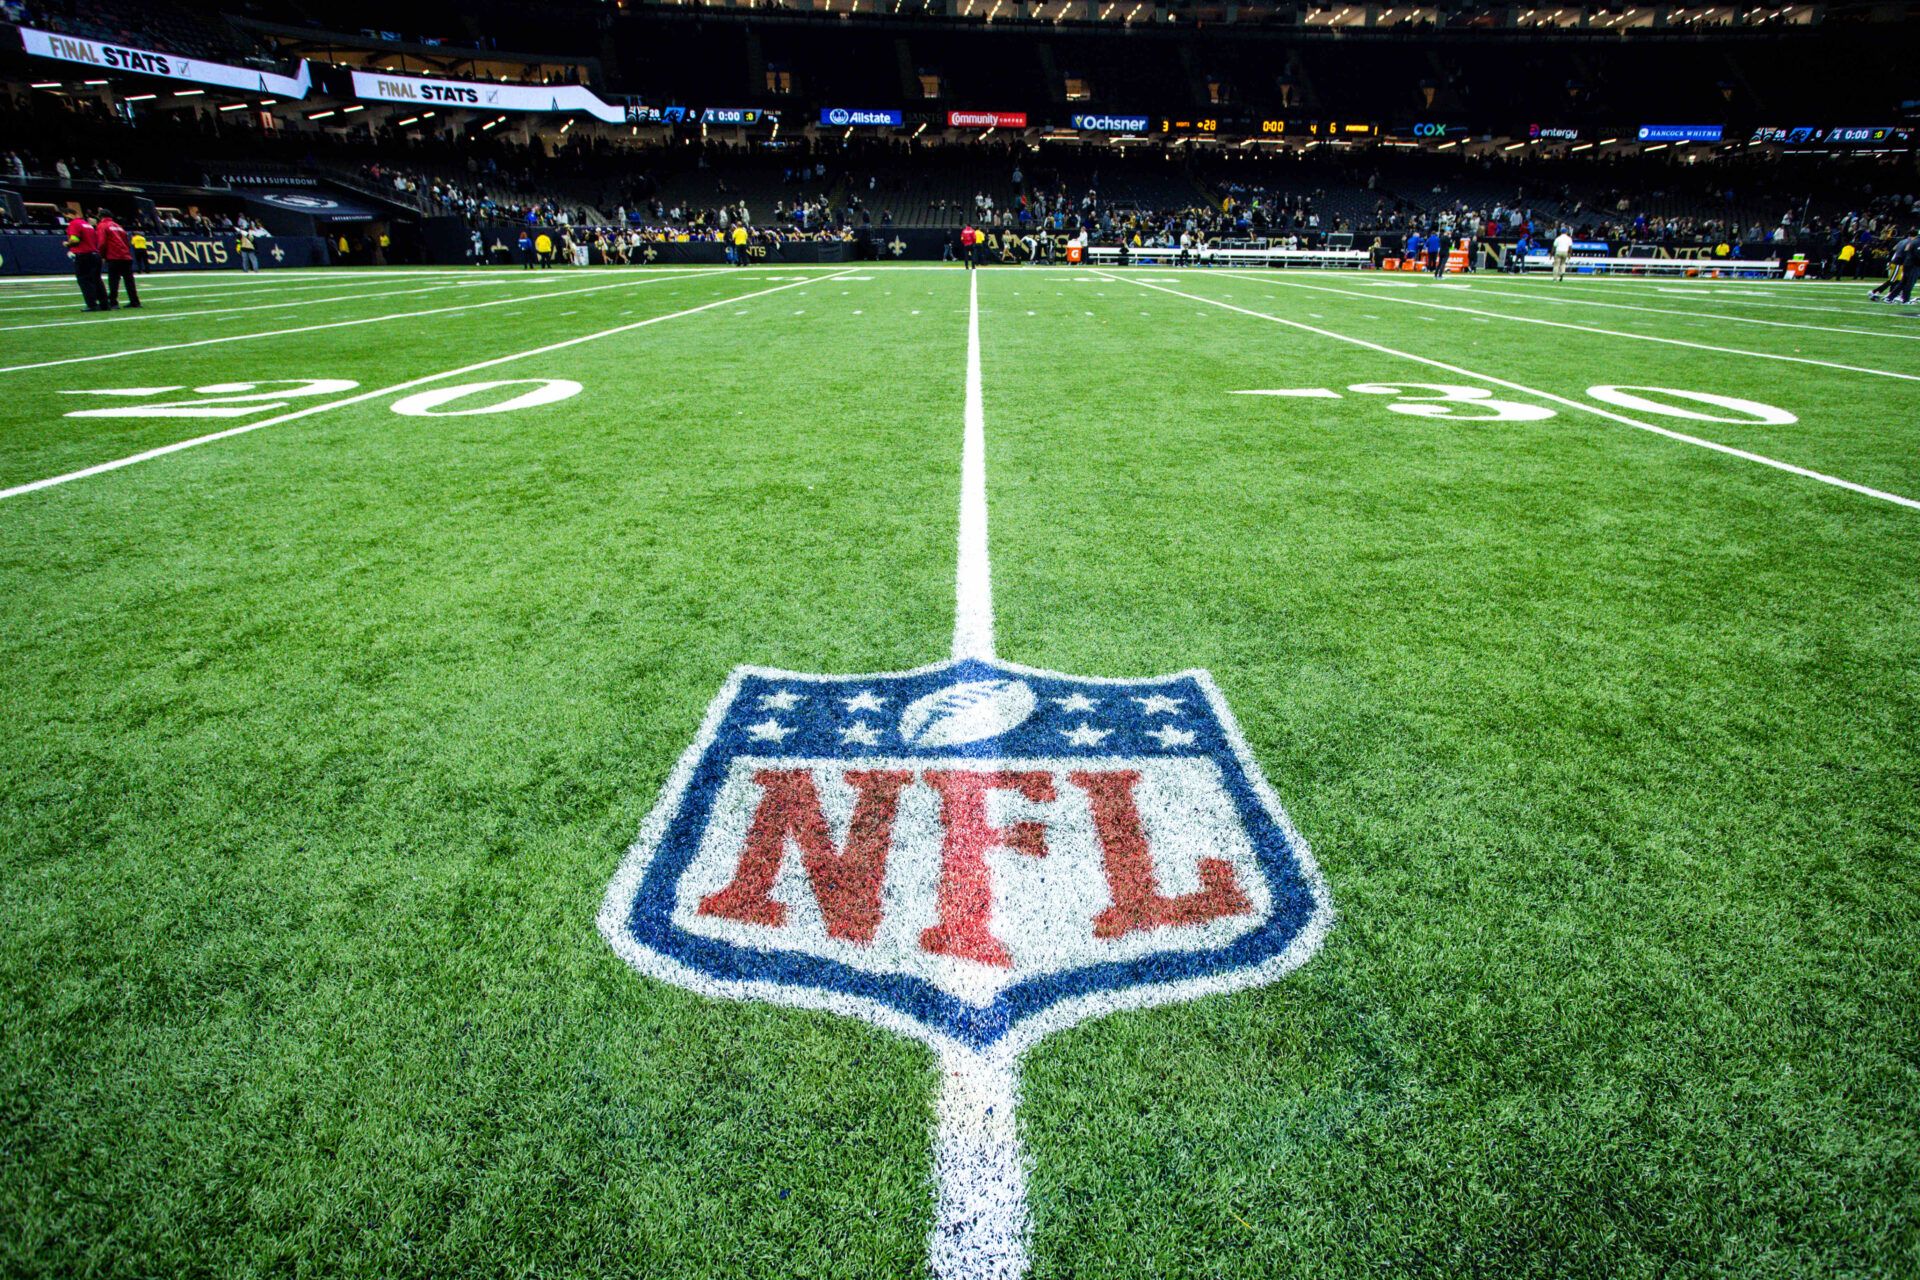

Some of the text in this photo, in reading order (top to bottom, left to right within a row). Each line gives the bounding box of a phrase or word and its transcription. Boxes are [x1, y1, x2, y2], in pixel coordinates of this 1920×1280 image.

[48, 35, 170, 75] FINAL STATS
[377, 80, 478, 103] FINAL STATS
[649, 108, 660, 118] 28
[689, 109, 696, 119] 6
[718, 110, 740, 121] 0:00
[849, 111, 891, 124] Allstate
[951, 112, 998, 127] Community
[1083, 115, 1146, 130] Ochsner
[1162, 120, 1170, 132] 3
[1203, 119, 1217, 131] 28
[1262, 120, 1285, 132] 0:00
[1309, 124, 1317, 135] 4
[1329, 121, 1337, 134] 6
[1413, 122, 1447, 136] COX
[1540, 127, 1578, 140] entergy
[1775, 129, 1787, 138] 28
[1815, 129, 1822, 138] 6
[1845, 129, 1868, 139] 0:00
[222, 175, 318, 186] CAESARS SUPERDOME
[145, 240, 228, 265] SAINTS
[698, 768, 1253, 969] NFL
